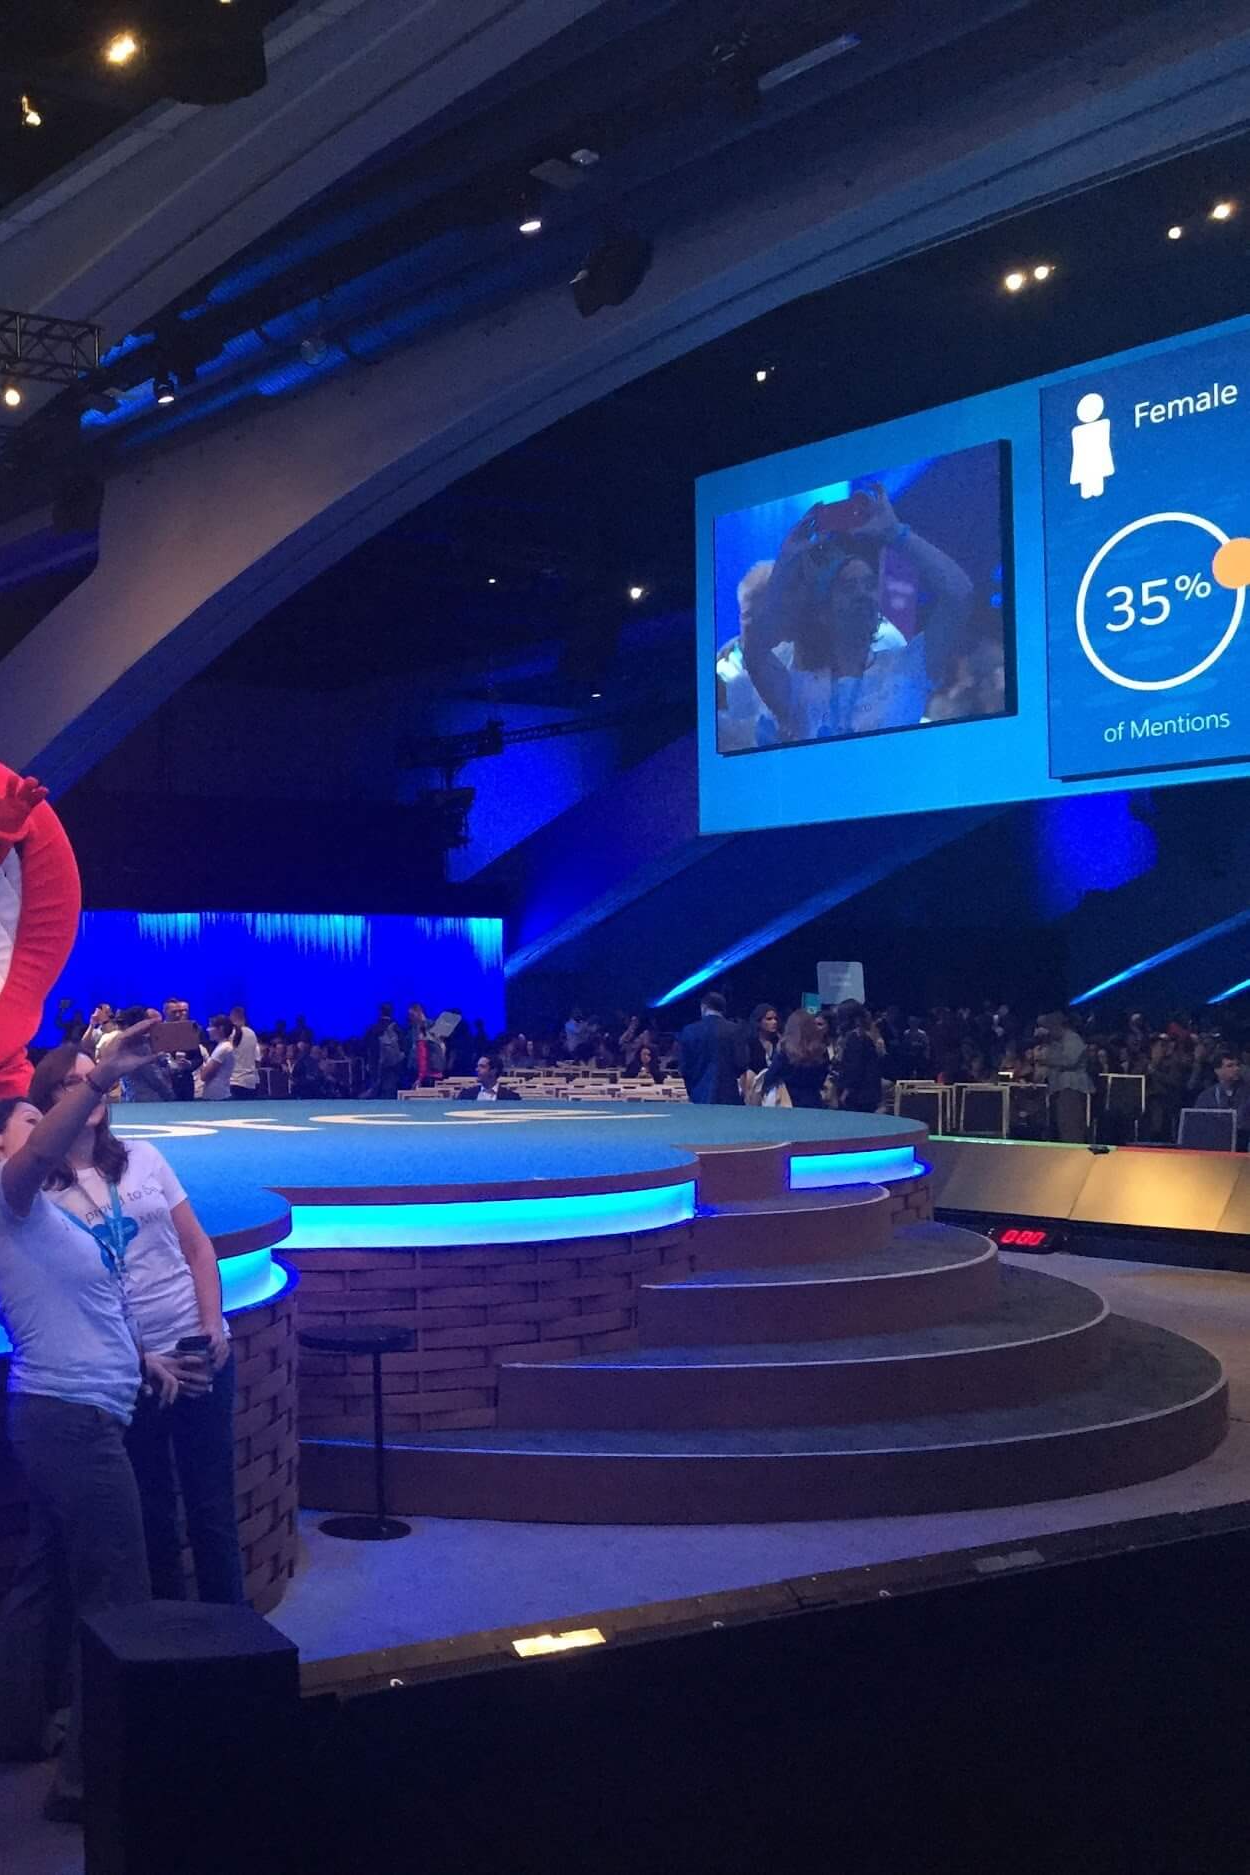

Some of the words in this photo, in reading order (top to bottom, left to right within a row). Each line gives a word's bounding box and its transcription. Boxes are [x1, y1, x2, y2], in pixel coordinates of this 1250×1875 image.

[1134, 382, 1239, 429] Female
[1105, 572, 1213, 633] 35%
[1103, 719, 1127, 743] of
[1130, 708, 1231, 741] Mentions
